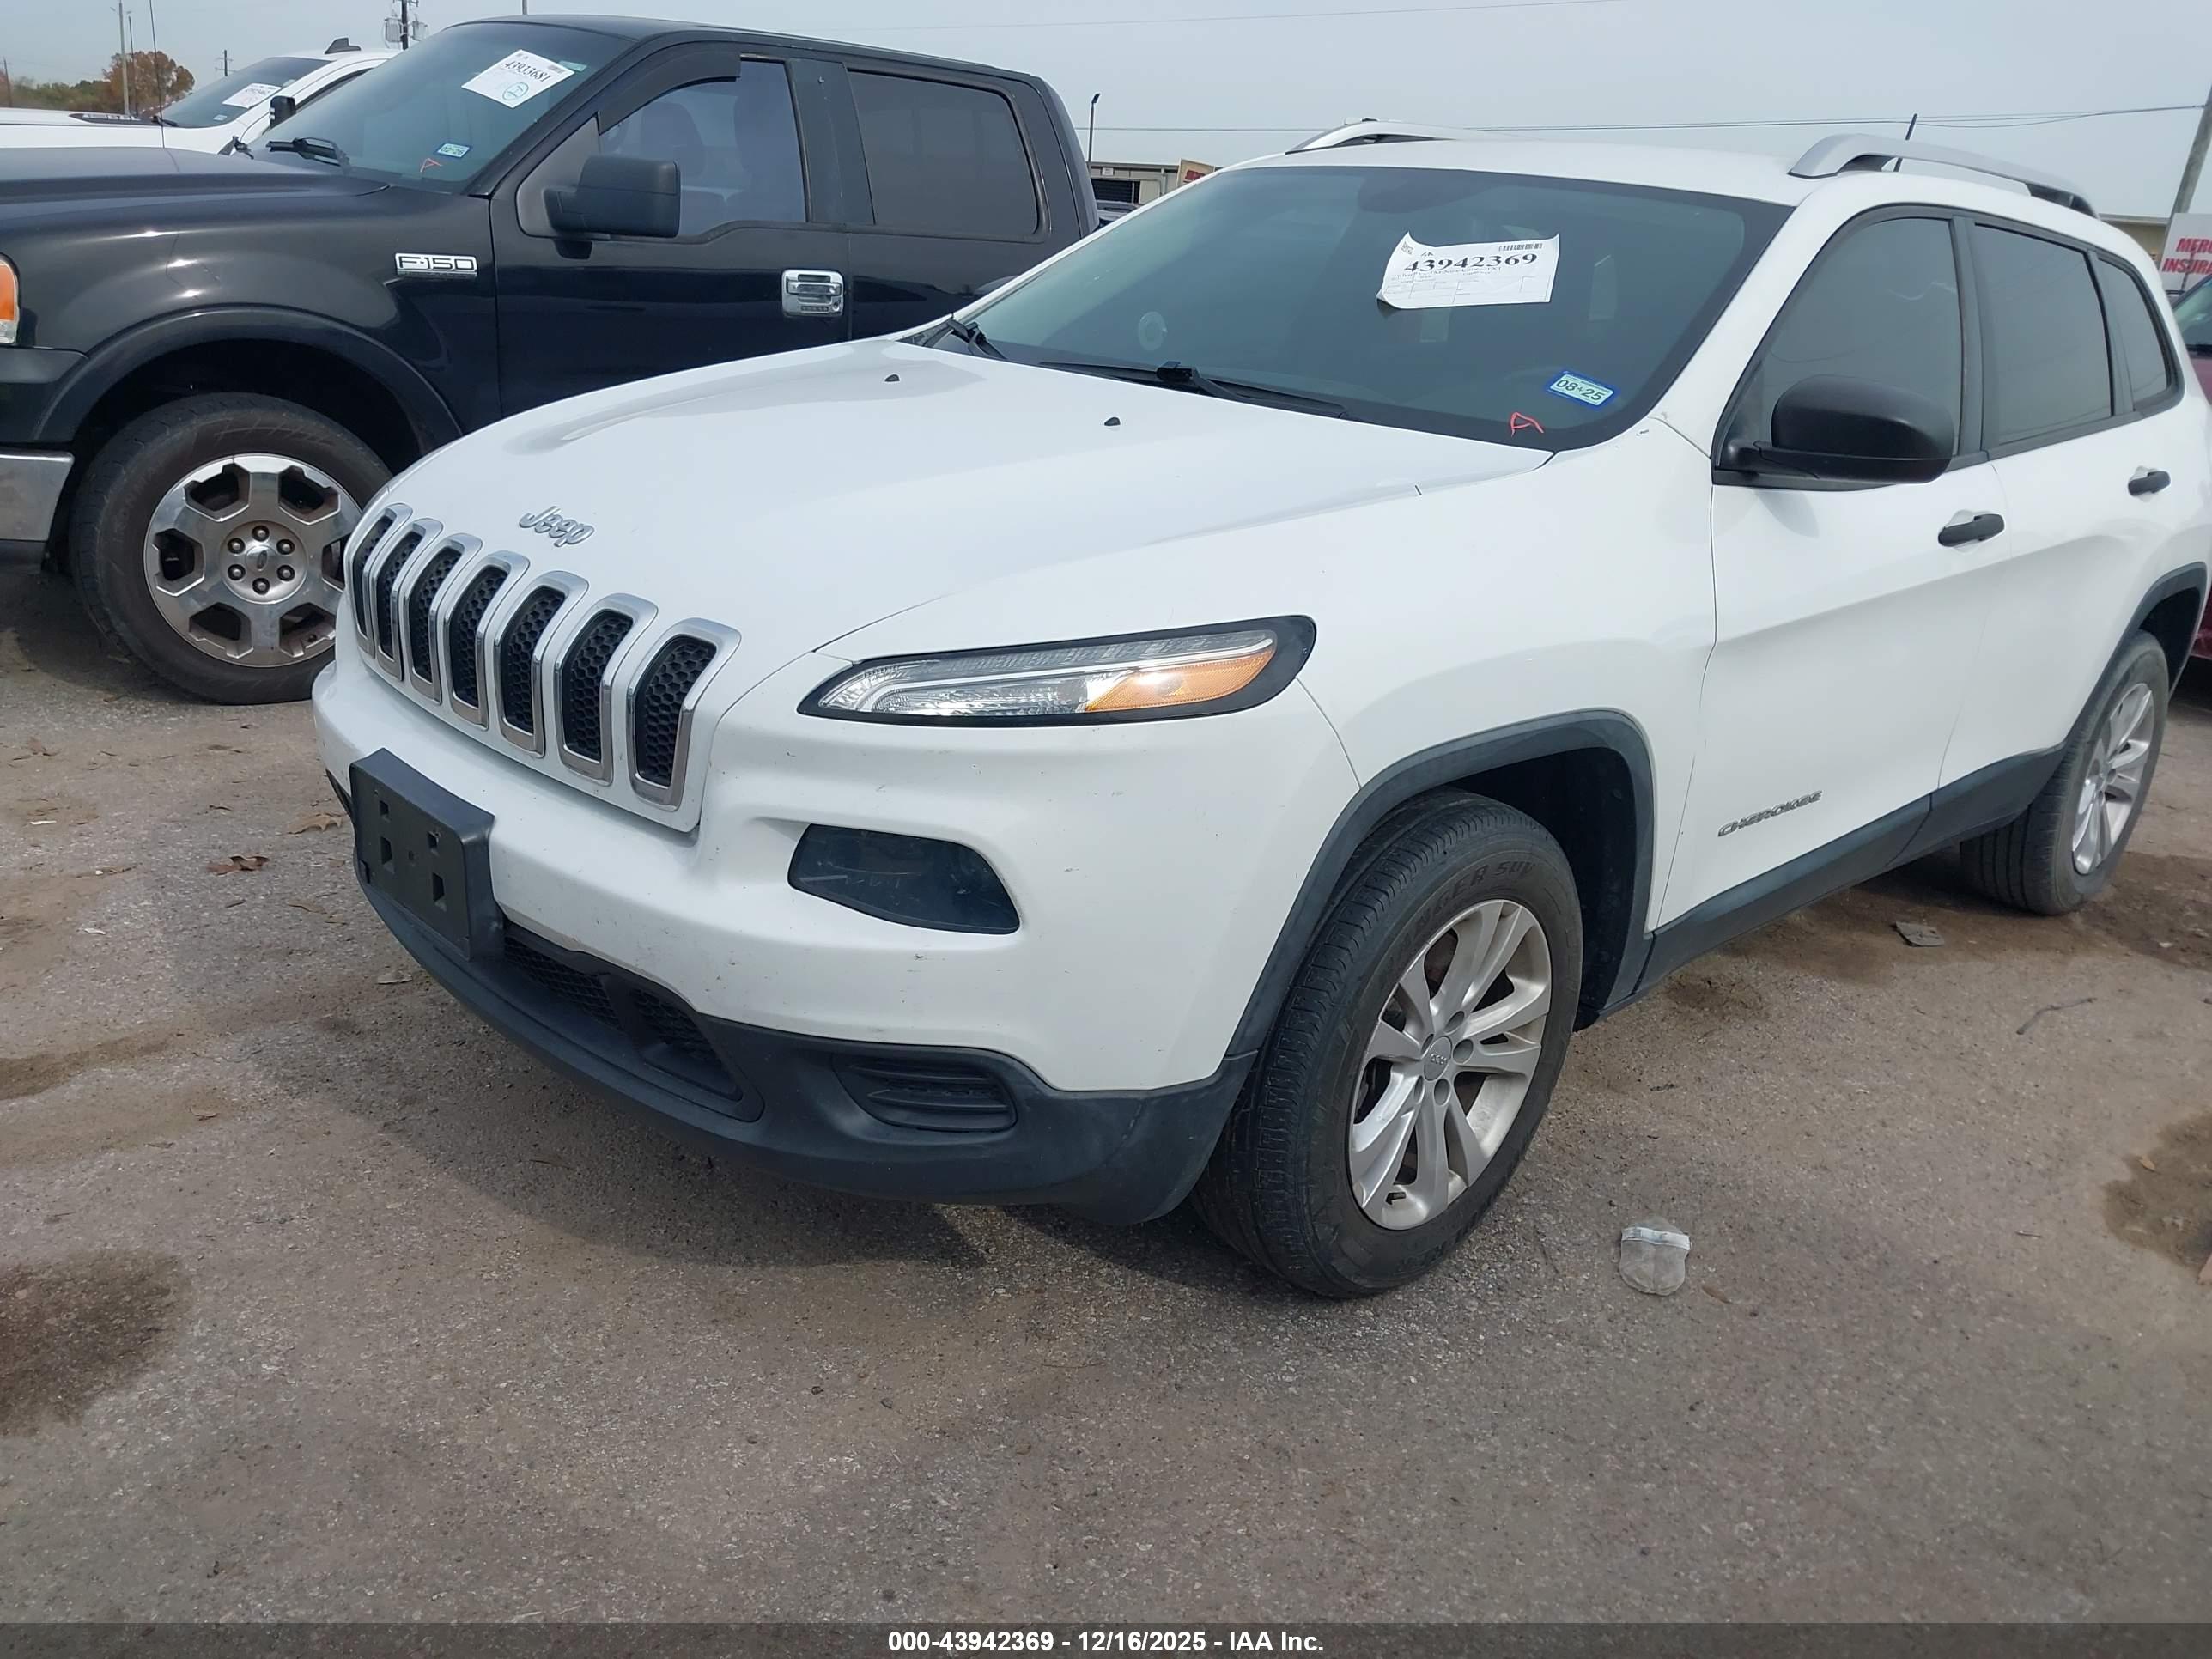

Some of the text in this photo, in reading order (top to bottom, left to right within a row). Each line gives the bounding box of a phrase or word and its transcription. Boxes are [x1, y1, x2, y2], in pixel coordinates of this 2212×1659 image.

[505, 60, 553, 82] 43933681
[1404, 253, 1537, 272] 43942369
[519, 506, 594, 547] Jeep
[1718, 790, 1822, 836] CHEROKEE
